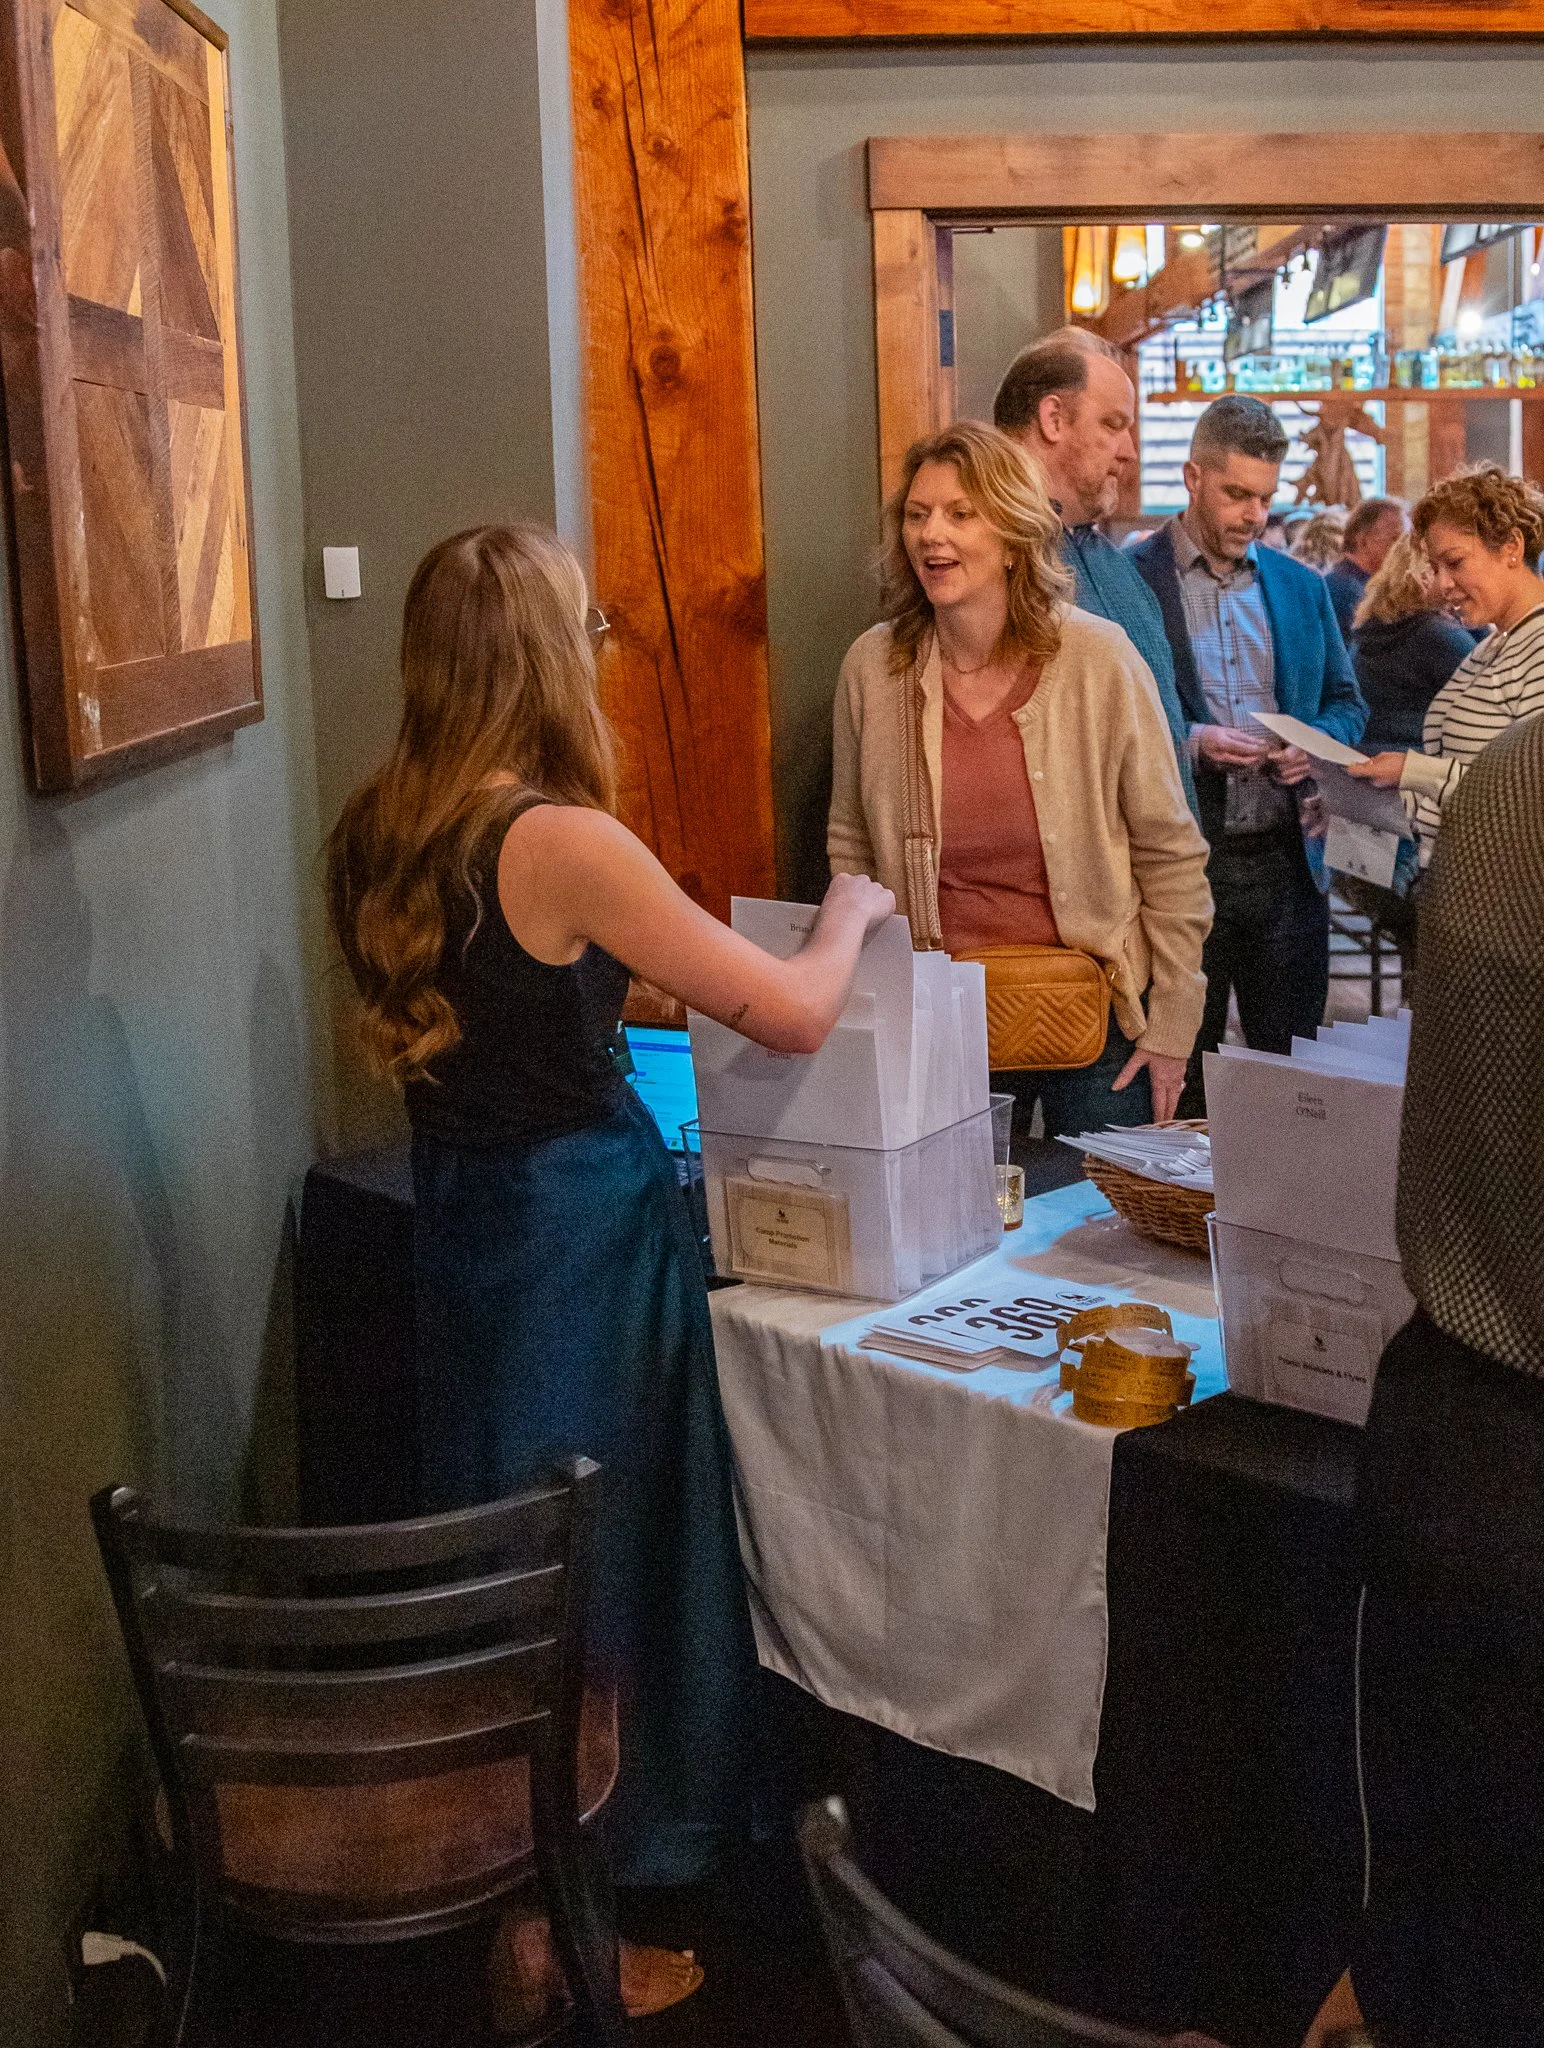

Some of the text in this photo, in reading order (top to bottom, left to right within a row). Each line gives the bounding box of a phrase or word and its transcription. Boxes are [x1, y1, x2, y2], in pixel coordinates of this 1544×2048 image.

[755, 1227, 808, 1242] Camp Promotion
[768, 1238, 796, 1248] Materials
[965, 1297, 1085, 1341] 369
